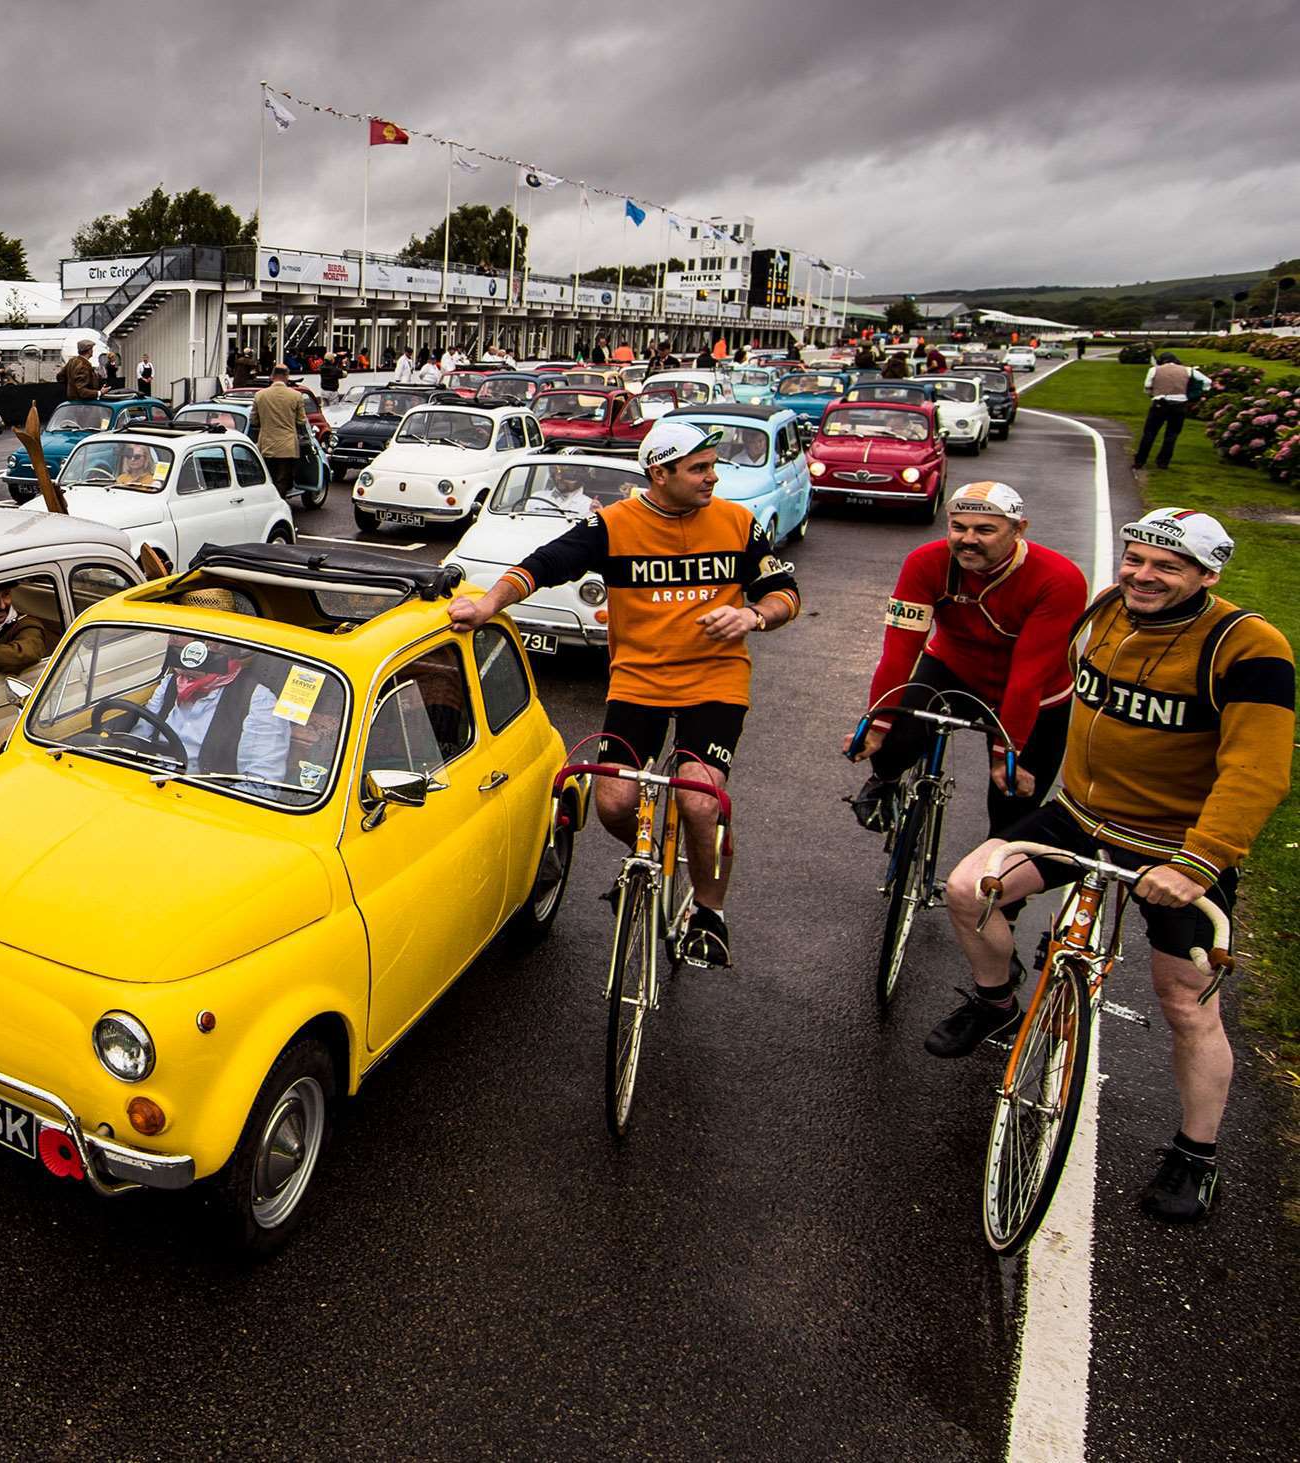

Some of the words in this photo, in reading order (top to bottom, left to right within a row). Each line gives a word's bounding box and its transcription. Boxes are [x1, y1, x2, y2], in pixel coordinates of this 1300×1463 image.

[88, 267, 107, 279] The
[631, 556, 736, 583] MOLTENI
[652, 588, 718, 602] ARCORE
